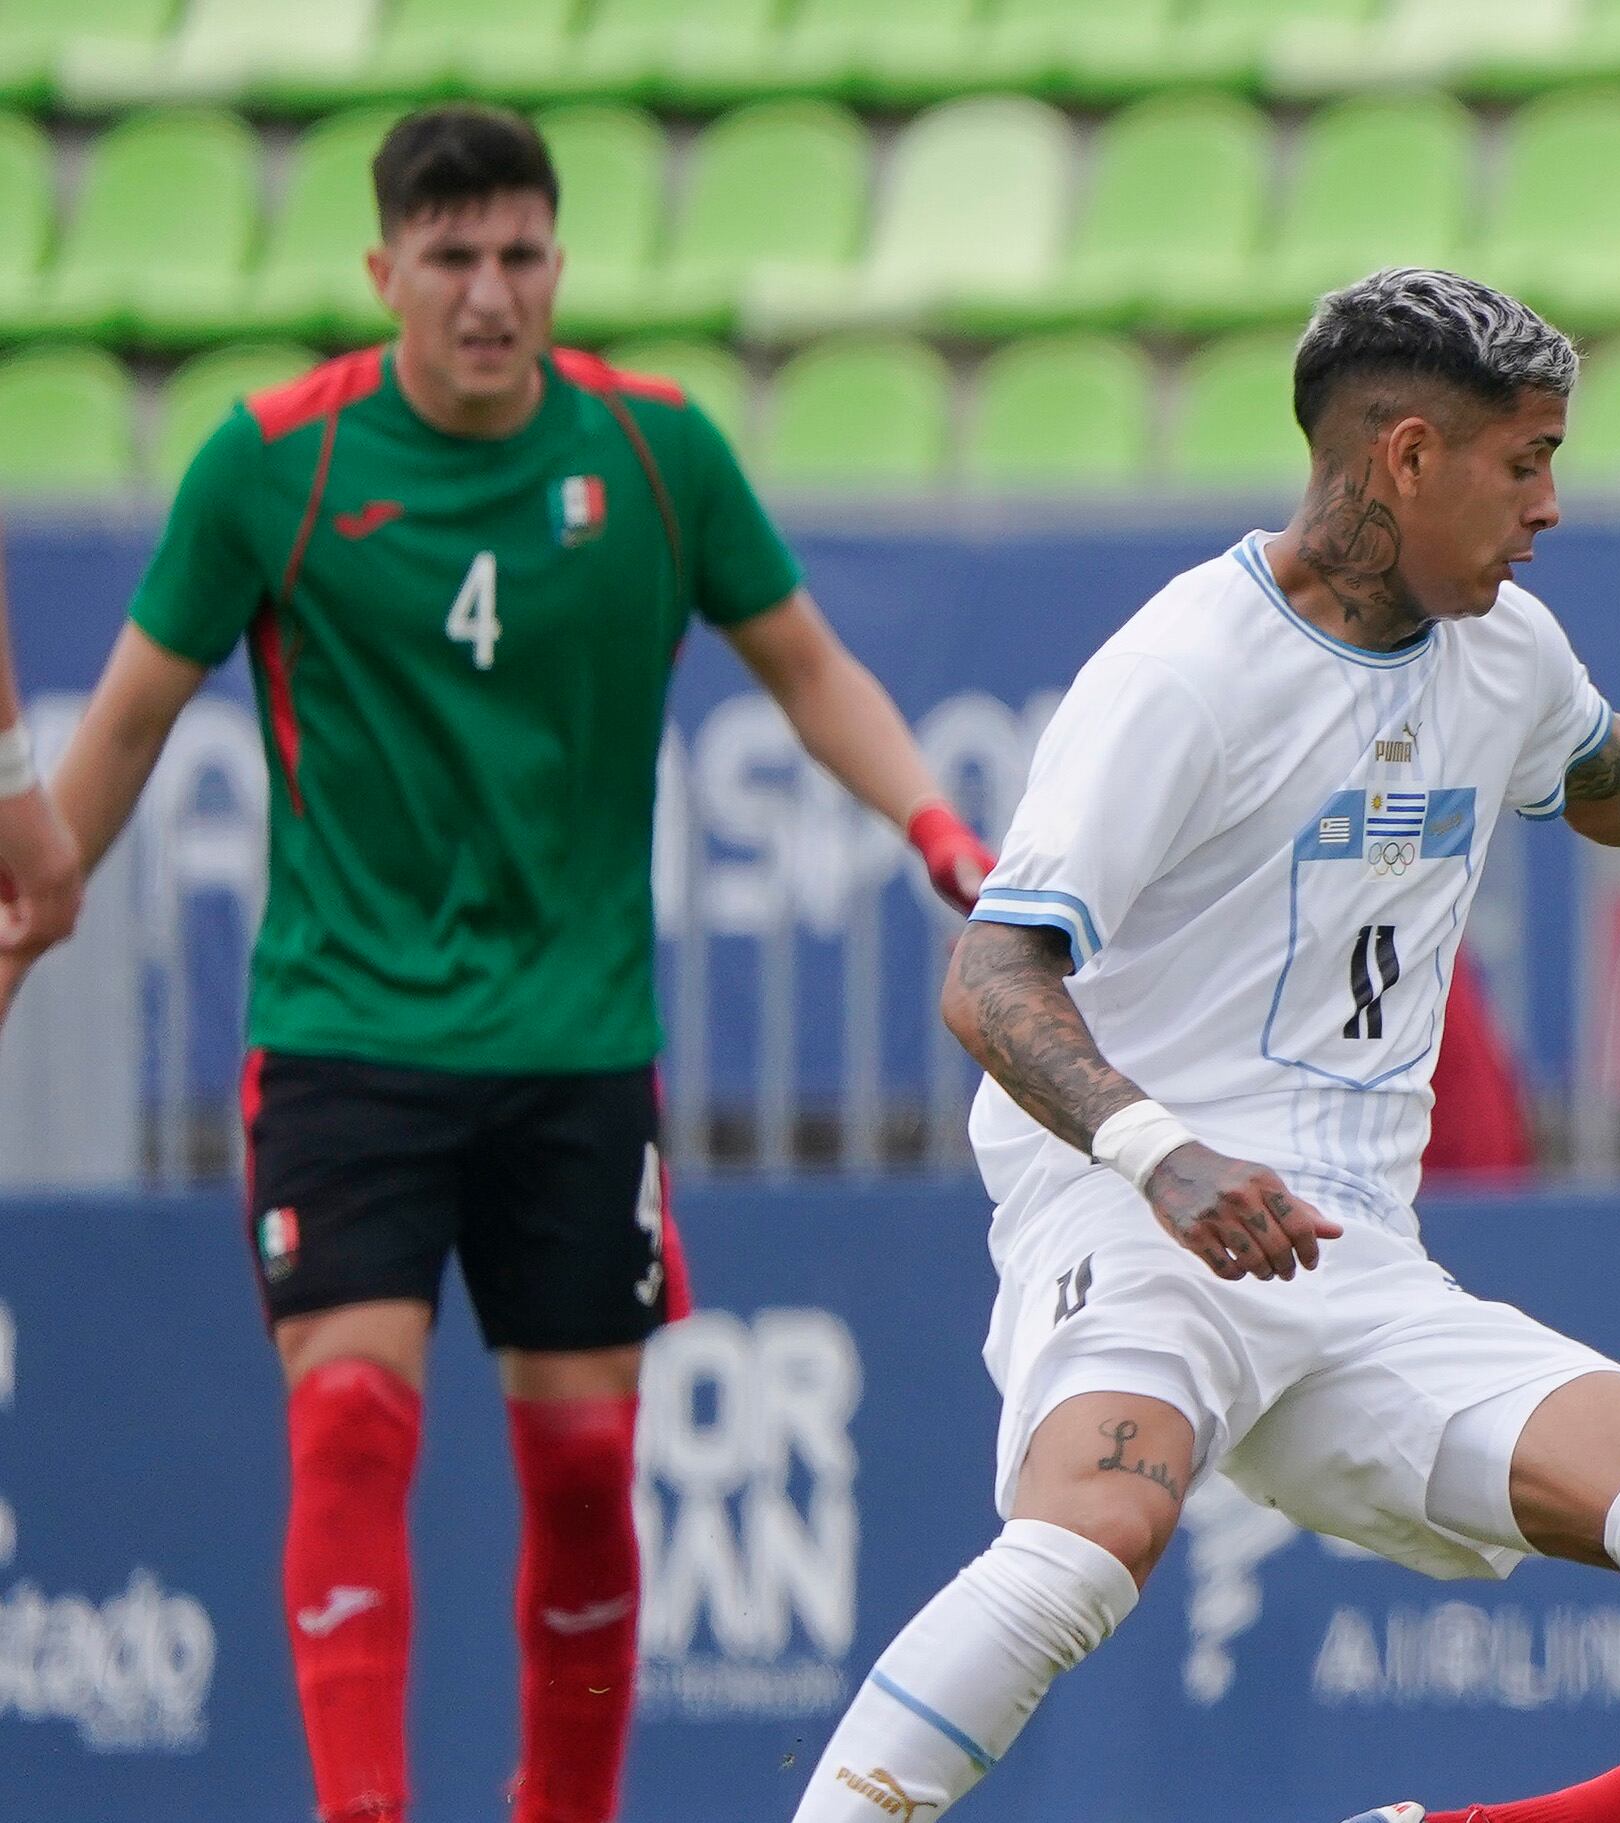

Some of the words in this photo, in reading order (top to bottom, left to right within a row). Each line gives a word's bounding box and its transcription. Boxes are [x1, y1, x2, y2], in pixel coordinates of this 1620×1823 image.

[446, 550, 501, 670] 4
[1375, 741, 1412, 762] PUMA
[1342, 924, 1400, 1040] 11
